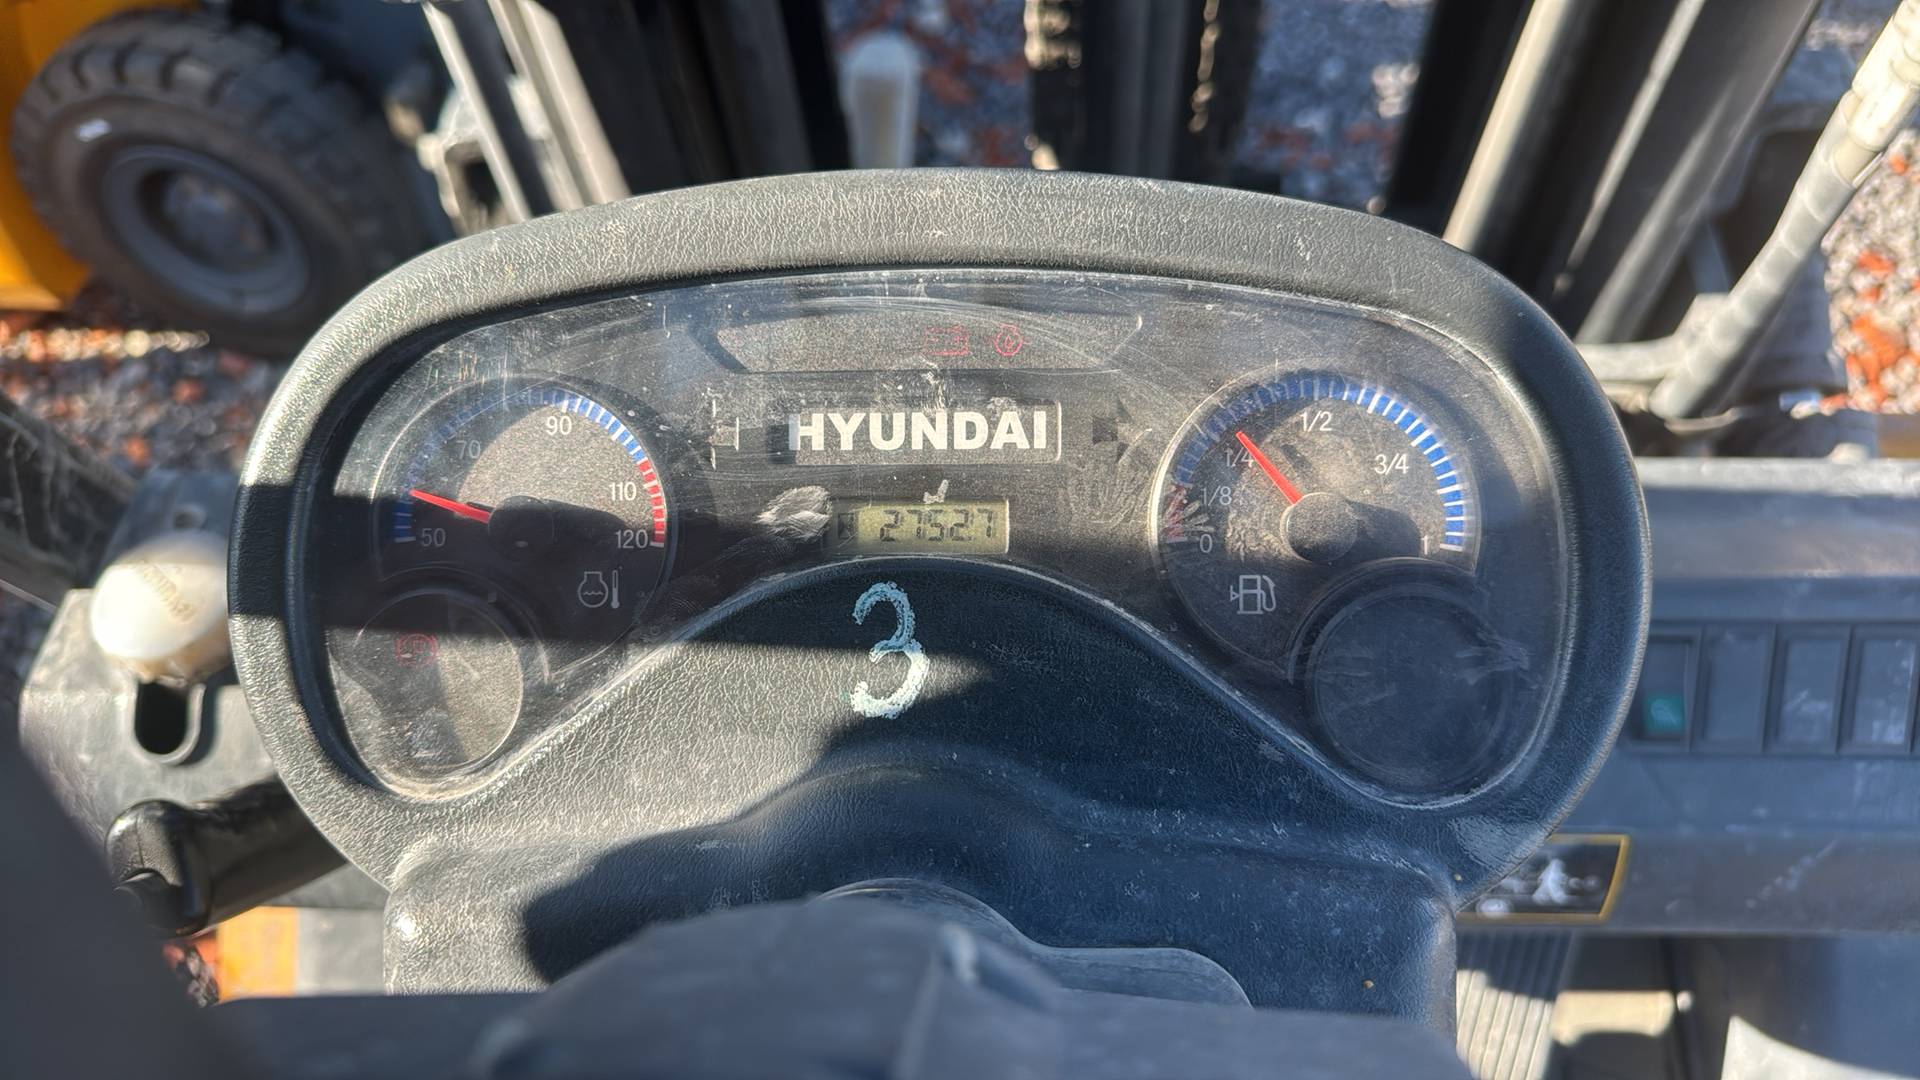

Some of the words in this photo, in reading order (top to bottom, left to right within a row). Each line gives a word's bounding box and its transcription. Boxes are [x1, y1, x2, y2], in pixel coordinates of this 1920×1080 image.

[546, 415, 572, 435] 90
[788, 410, 1047, 450] HYUNDAI
[1300, 411, 1333, 432] 1/2
[458, 440, 481, 459] 70
[1225, 446, 1254, 468] 1/4
[1374, 453, 1409, 475] 3/4
[609, 482, 637, 501] 110
[1200, 485, 1232, 506] 1/8
[420, 528, 446, 547] 50
[616, 529, 648, 549] 120
[1200, 533, 1213, 553] 0
[850, 581, 931, 720] 3
